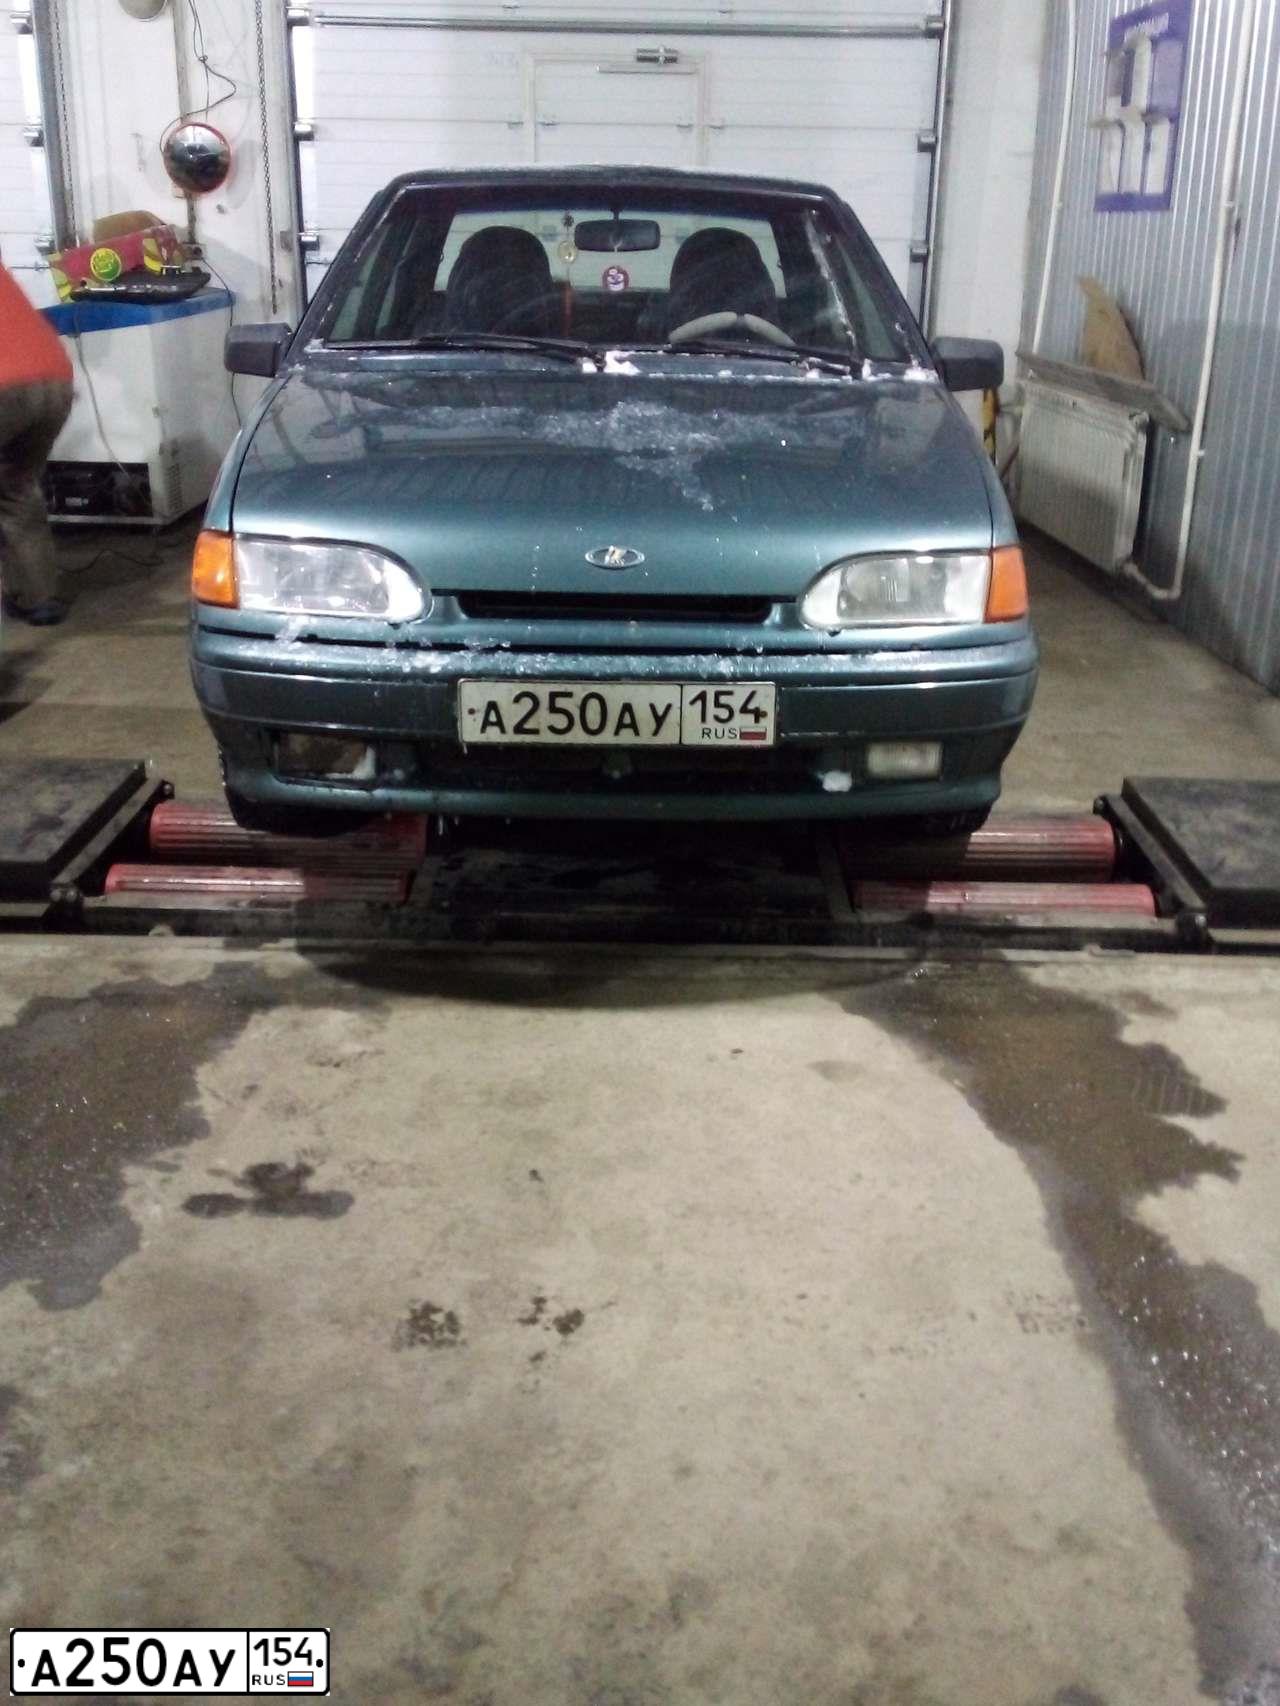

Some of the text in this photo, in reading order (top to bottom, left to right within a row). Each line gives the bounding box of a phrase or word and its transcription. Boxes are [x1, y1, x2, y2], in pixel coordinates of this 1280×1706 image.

[480, 690, 761, 737] А250АУ 154
[701, 728, 738, 739] RUS
